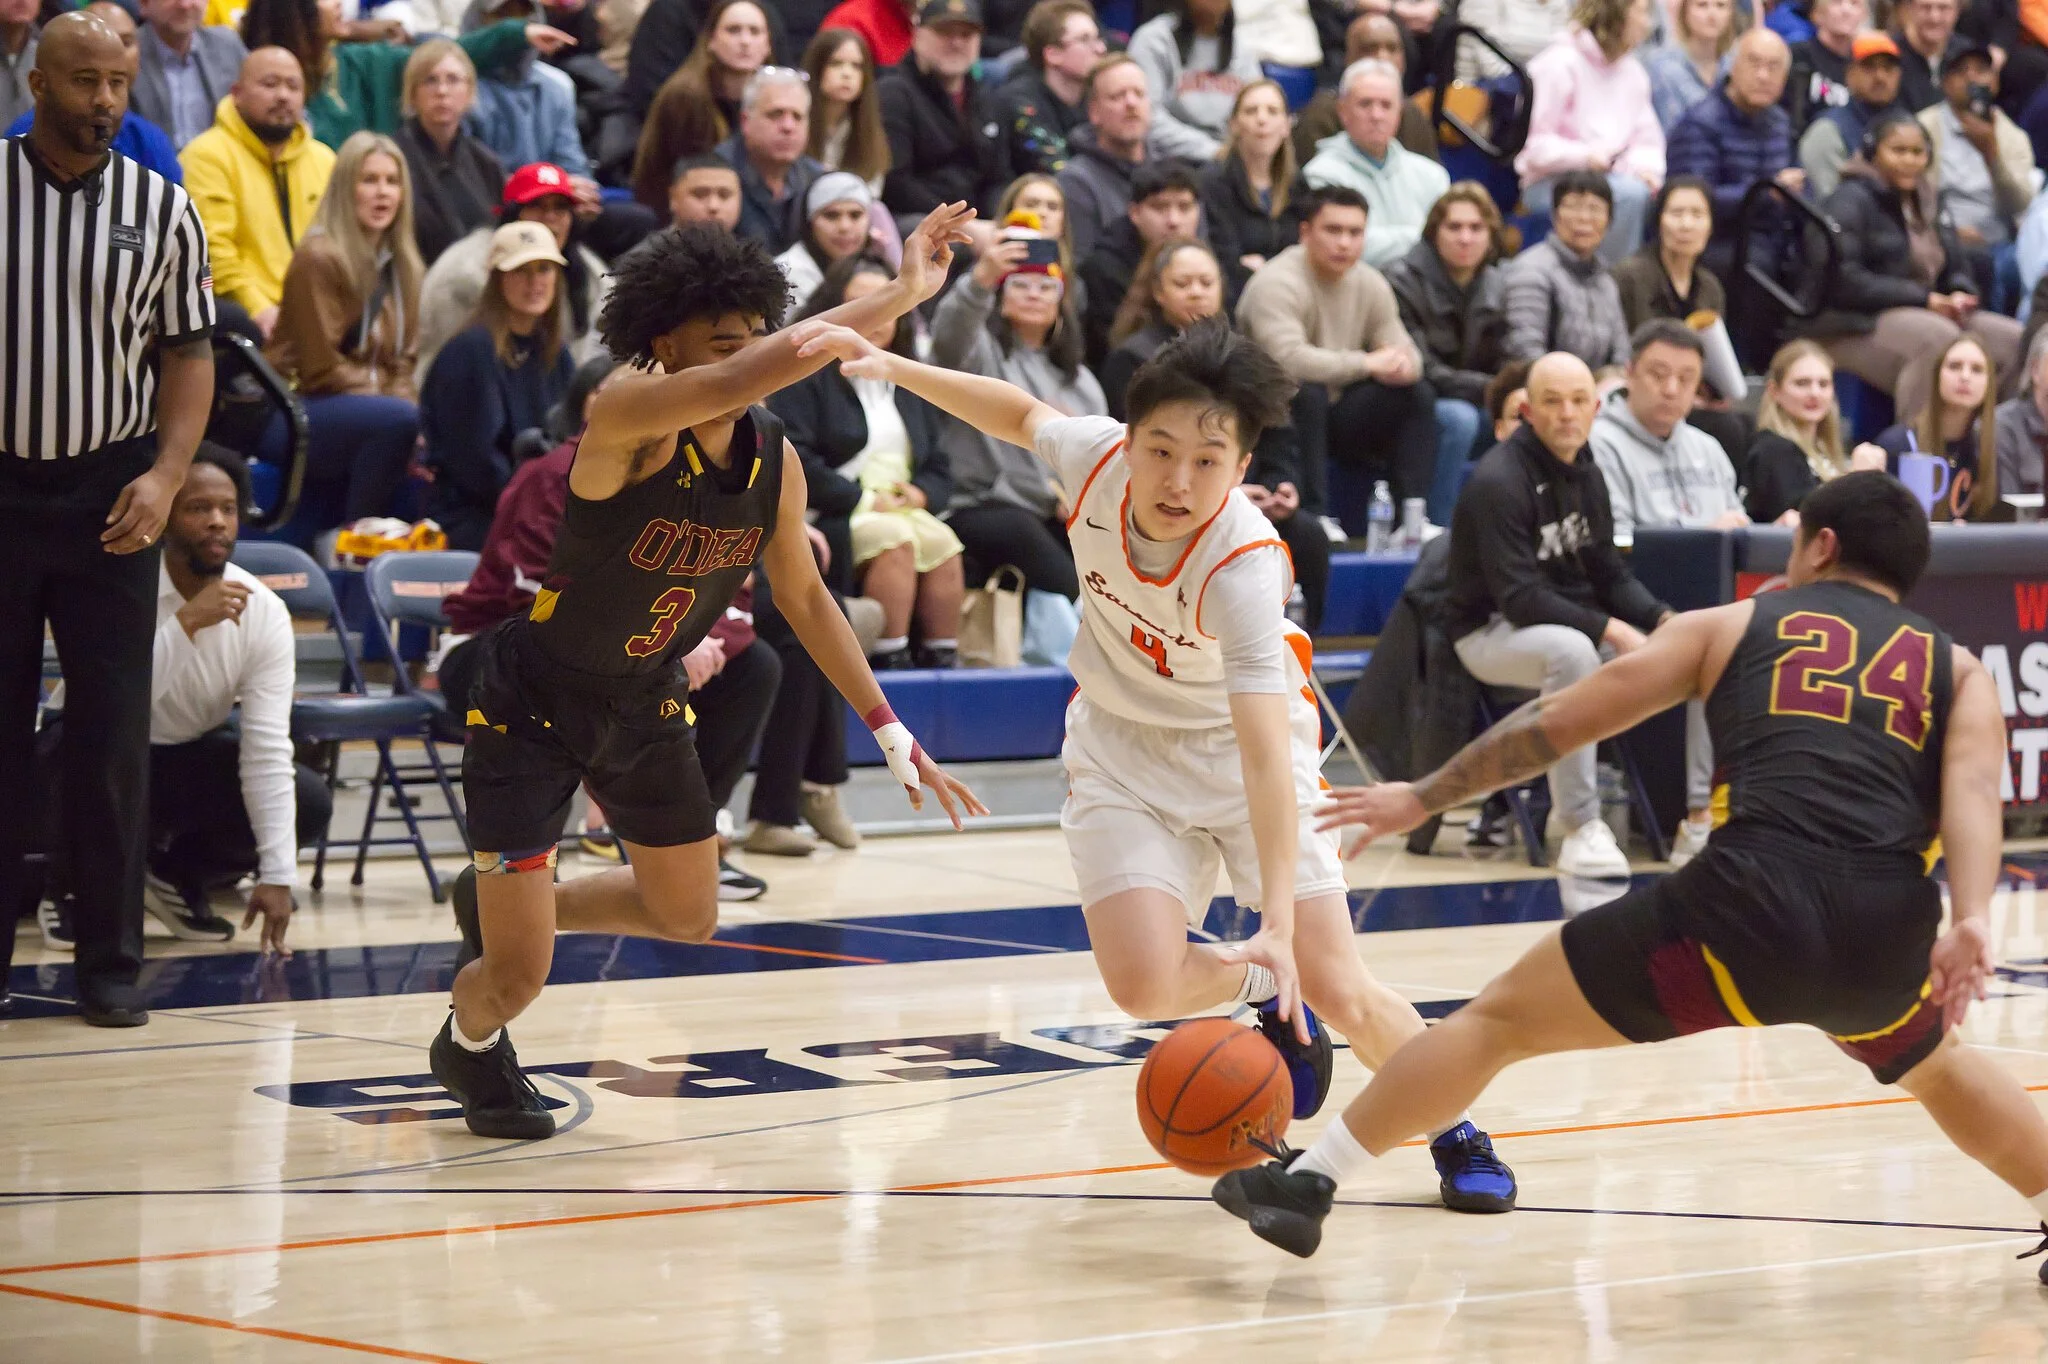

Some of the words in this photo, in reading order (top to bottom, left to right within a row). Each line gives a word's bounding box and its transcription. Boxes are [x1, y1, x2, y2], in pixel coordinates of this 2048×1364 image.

[629, 518, 763, 576] O'DEA
[624, 586, 696, 657] 3
[1130, 623, 1173, 678] 4
[1769, 610, 1935, 752] 24
